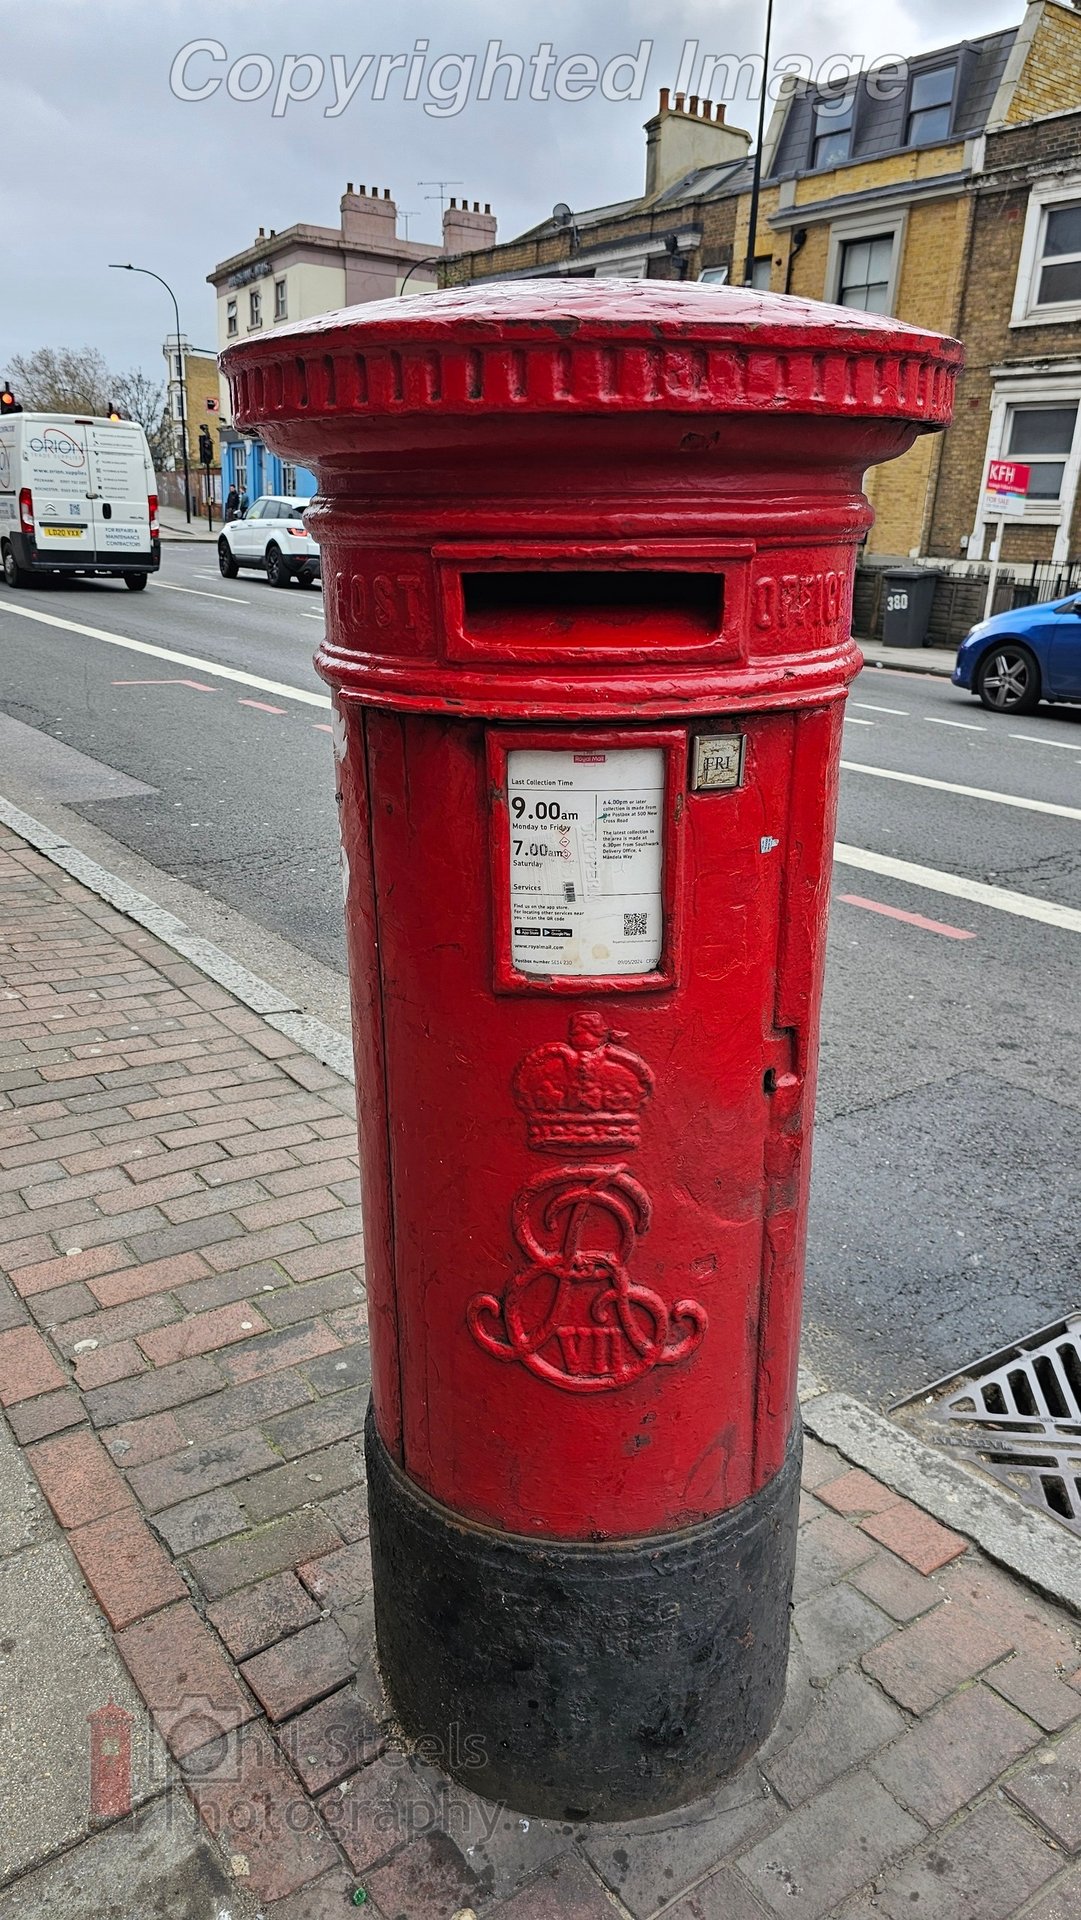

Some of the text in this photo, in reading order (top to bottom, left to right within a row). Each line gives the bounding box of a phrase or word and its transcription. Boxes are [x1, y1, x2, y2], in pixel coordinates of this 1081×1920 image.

[30, 438, 84, 455] ORION
[989, 464, 1016, 482] KFH
[886, 594, 908, 611] 380
[704, 756, 730, 770] FRI
[511, 797, 578, 820] 9.00am
[513, 860, 543, 868] Saturday
